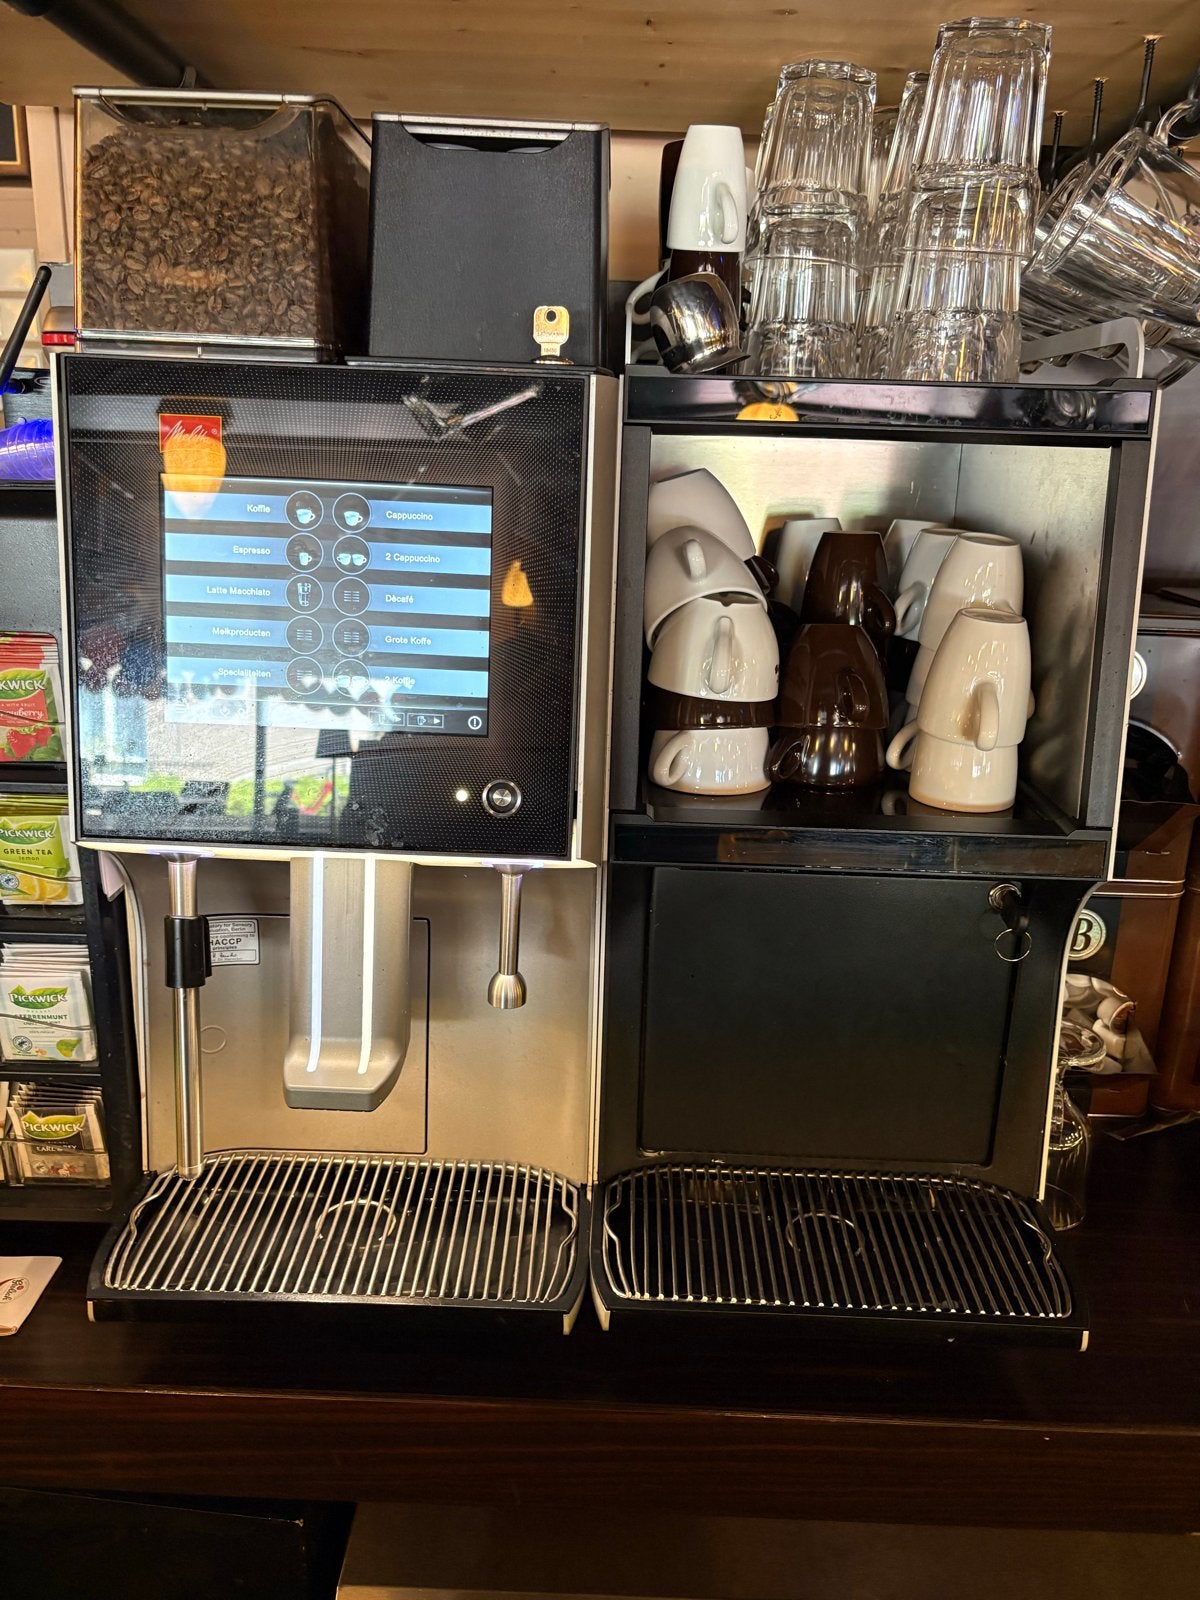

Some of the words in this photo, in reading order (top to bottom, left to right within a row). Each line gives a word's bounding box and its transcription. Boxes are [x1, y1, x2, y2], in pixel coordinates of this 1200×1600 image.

[246, 504, 271, 513] Koffie
[385, 510, 433, 521] Cappuccino
[232, 545, 271, 555] Espresso
[385, 552, 391, 561] 2
[393, 553, 441, 563] Cappuccino
[206, 585, 228, 594] Latte
[229, 587, 271, 596] Macchiato
[212, 627, 271, 637] Melkproducten
[384, 635, 409, 644] Grote
[0, 679, 46, 690] KWICK
[1072, 918, 1094, 951] B
[10, 993, 67, 1003] PICKWICK
[23, 1121, 83, 1132] PICKWICK
